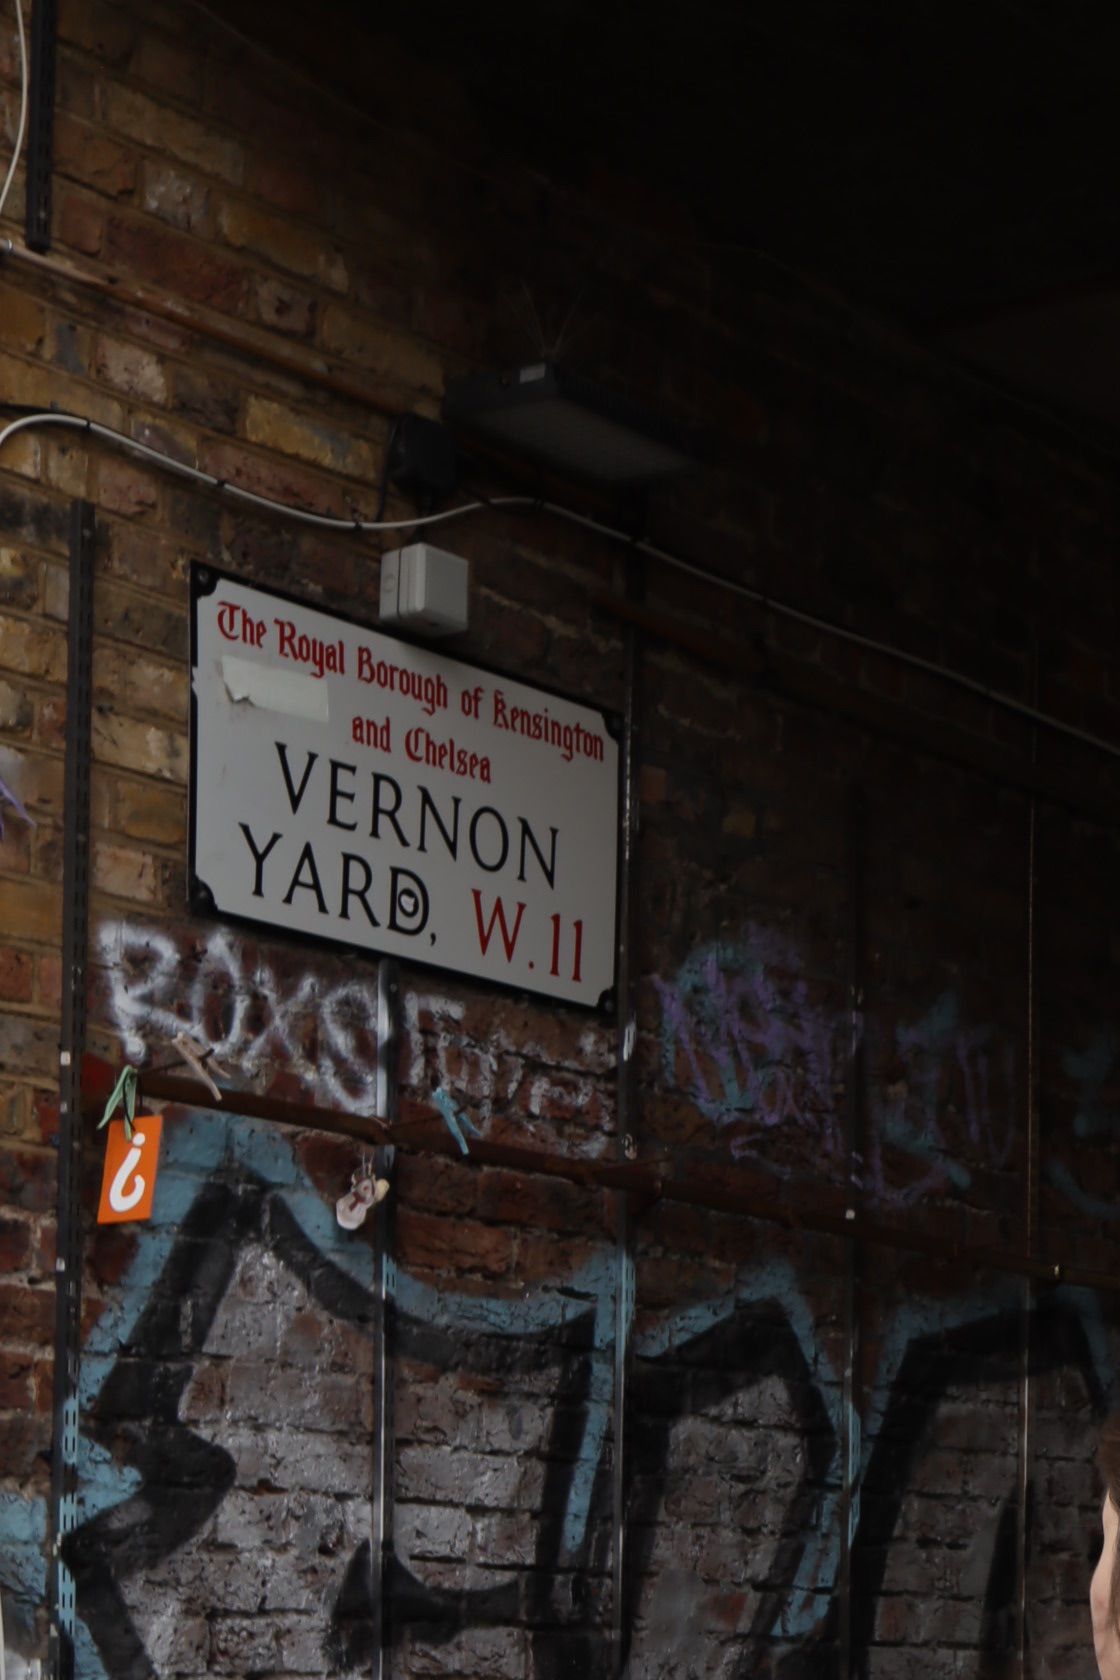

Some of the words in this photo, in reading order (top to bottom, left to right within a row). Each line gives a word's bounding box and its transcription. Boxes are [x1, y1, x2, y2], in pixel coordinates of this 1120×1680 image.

[217, 601, 267, 649] The
[274, 619, 345, 679] Royal
[357, 646, 448, 716] Borough
[460, 686, 485, 721] of
[493, 691, 604, 762] Kensington
[352, 715, 391, 753] and
[405, 728, 492, 783] Chelsea
[275, 741, 559, 890] VERNON
[471, 889, 584, 983] W.11
